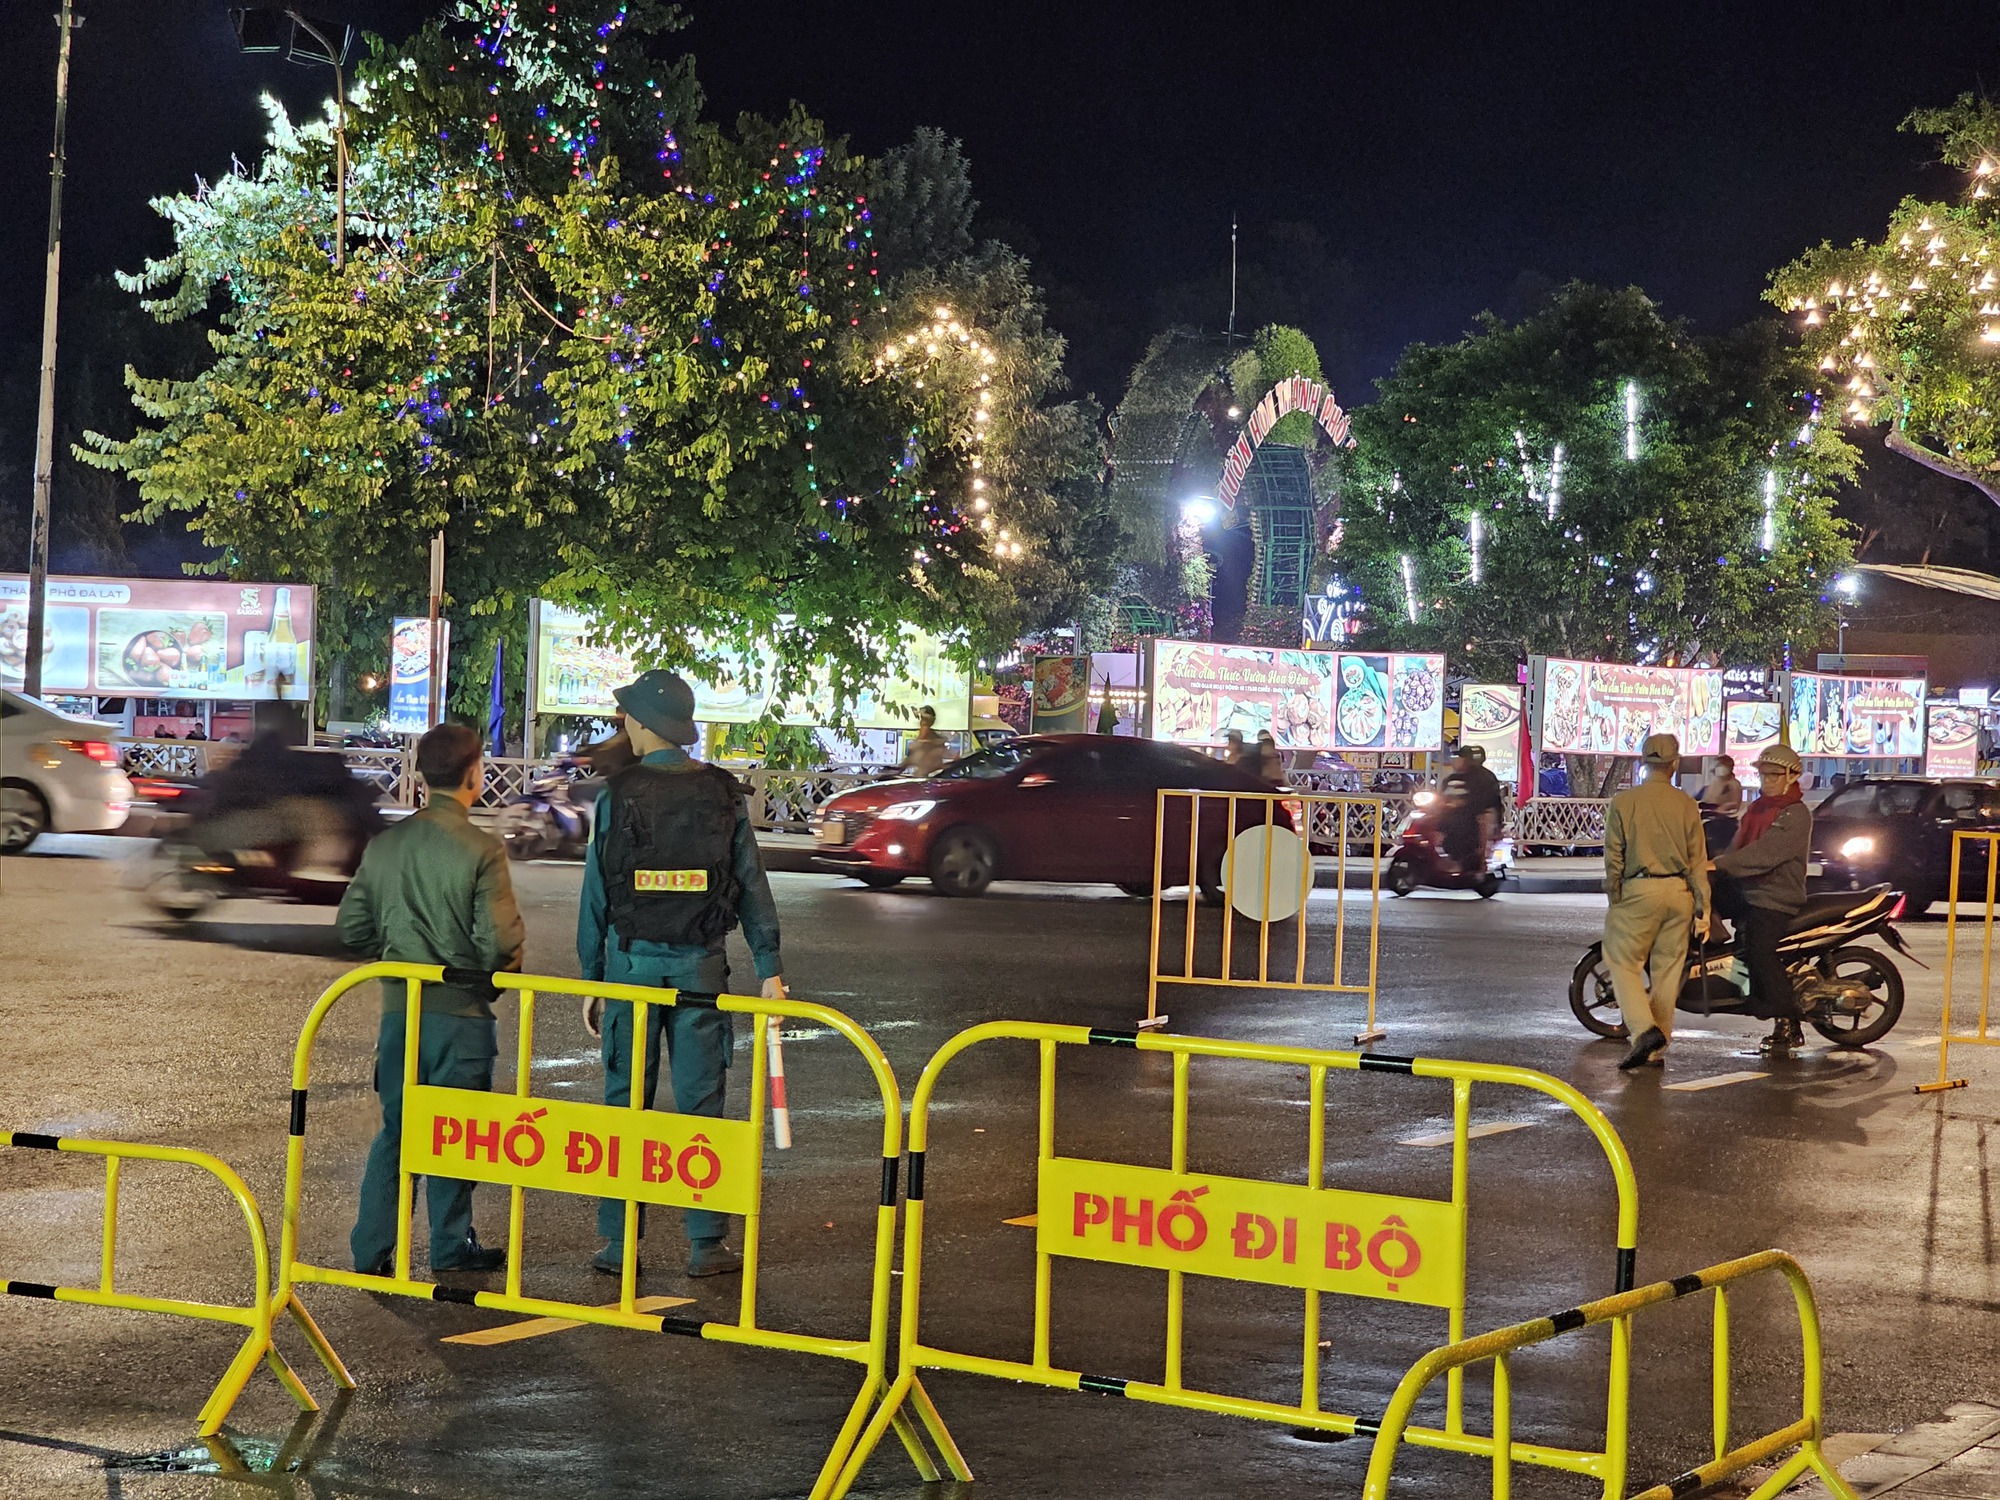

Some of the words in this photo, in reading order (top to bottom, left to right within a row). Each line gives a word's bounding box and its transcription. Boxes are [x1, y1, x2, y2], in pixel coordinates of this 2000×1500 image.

[1218, 430, 1253, 511] VƯỜN
[1248, 390, 1277, 449] HOA
[1275, 369, 1322, 417] THÀNH
[1319, 394, 1351, 446] PHỐ
[1268, 670, 1288, 685] Hoa
[432, 1107, 549, 1168] PHỐ
[564, 1131, 621, 1178] ĐI
[642, 1133, 722, 1202] BỘ
[1073, 1185, 1210, 1252] PHỐ
[1230, 1211, 1297, 1265] ĐI
[1325, 1214, 1422, 1293] BỘ
